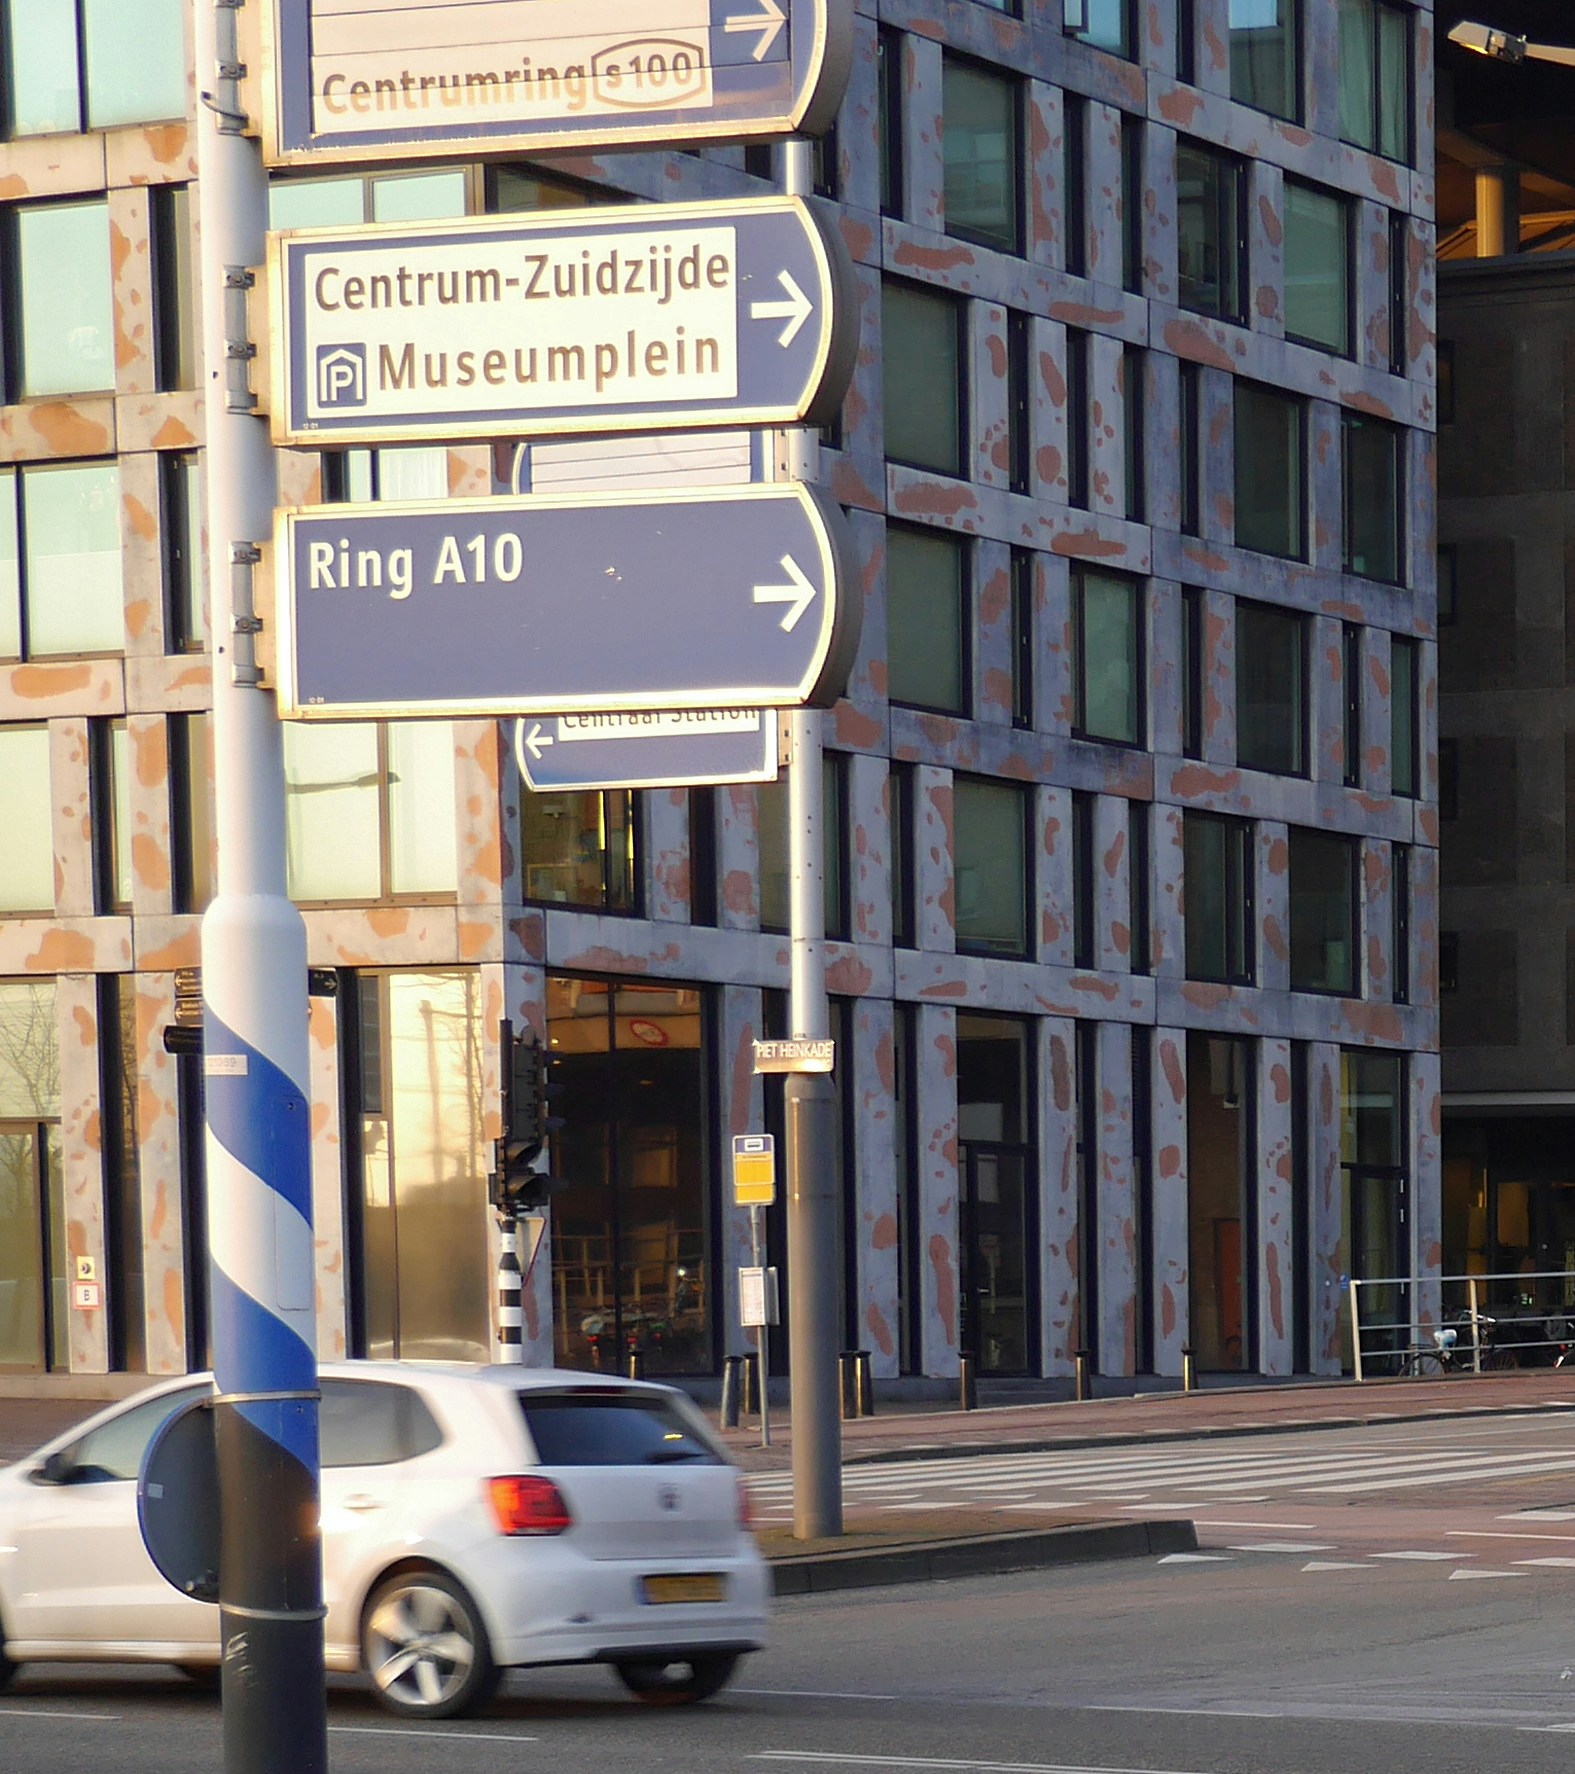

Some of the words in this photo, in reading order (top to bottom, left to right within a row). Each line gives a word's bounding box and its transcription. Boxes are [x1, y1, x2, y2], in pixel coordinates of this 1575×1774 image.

[323, 57, 587, 115] Centrumring
[605, 52, 693, 89] s100
[315, 243, 730, 312] Centrum-Zuidzijde
[378, 325, 720, 393] Museumplein
[310, 538, 413, 600] Ring
[433, 533, 523, 584] A10
[757, 1043, 778, 1058] PIET
[780, 1043, 832, 1058] HEINKADE
